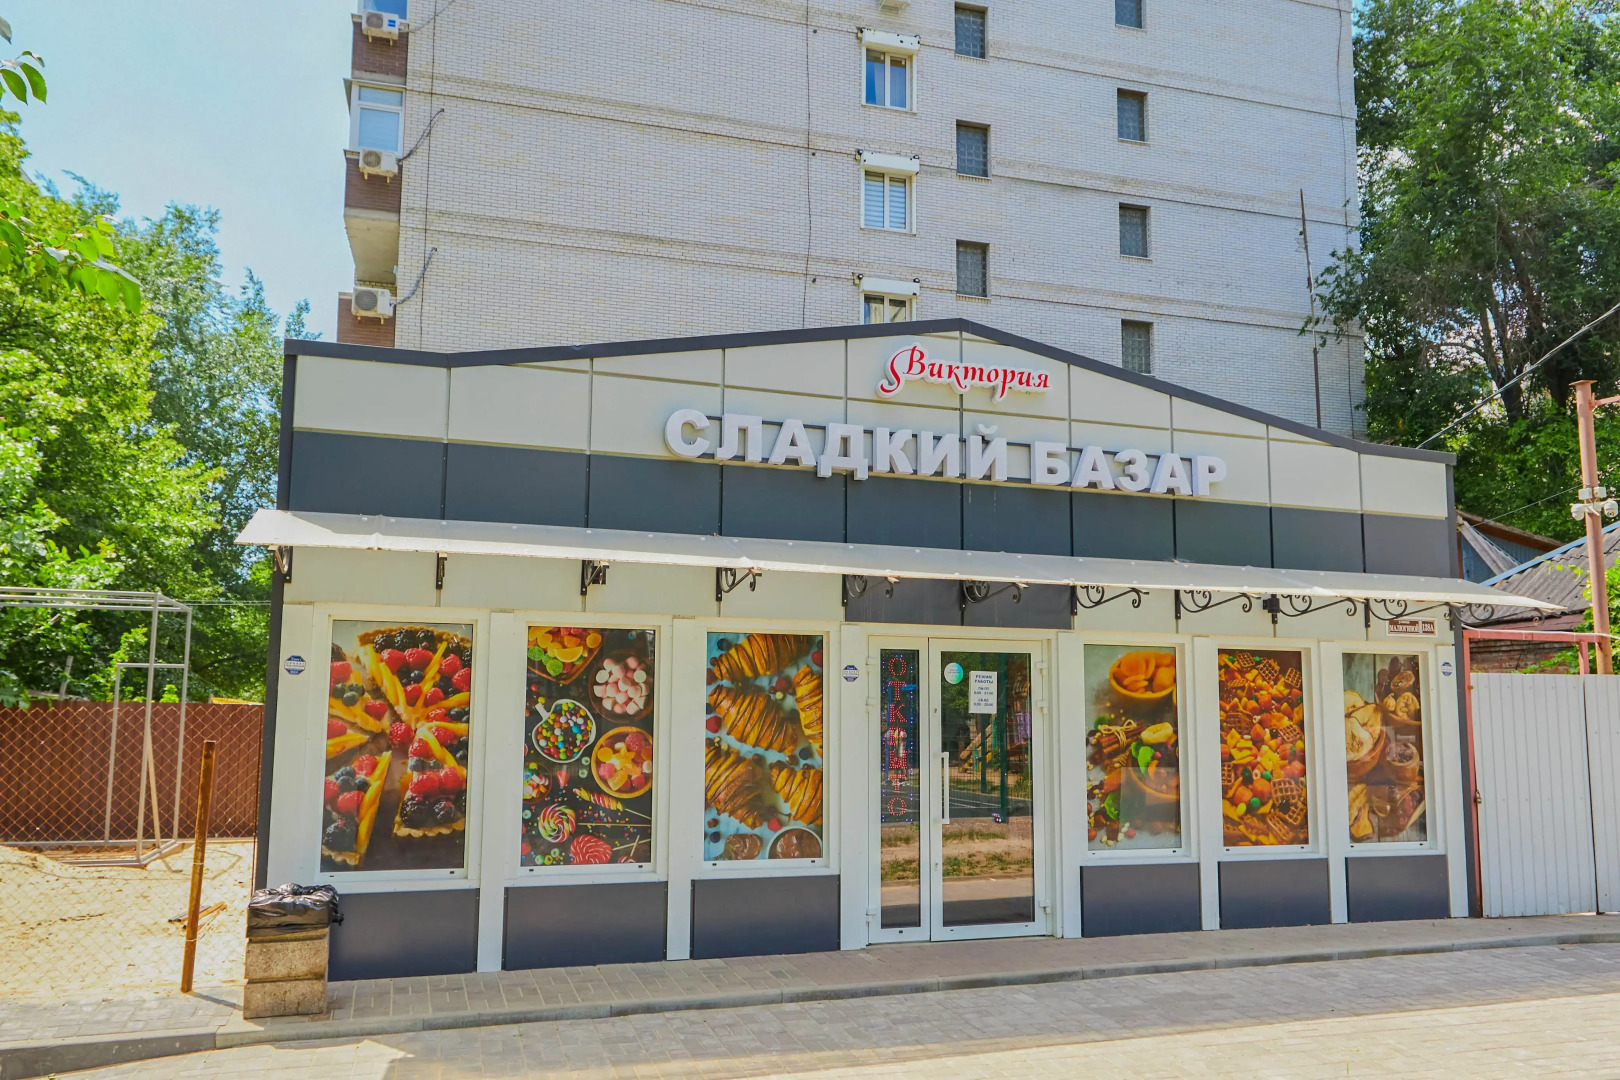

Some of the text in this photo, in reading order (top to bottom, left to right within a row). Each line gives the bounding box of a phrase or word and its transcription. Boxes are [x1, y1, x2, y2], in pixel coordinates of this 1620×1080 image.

[880, 345, 1050, 399] Виктория
[664, 409, 1227, 497] СЛАДКИЙ БАЗАР
[887, 657, 908, 816] ОТКРЫТО
